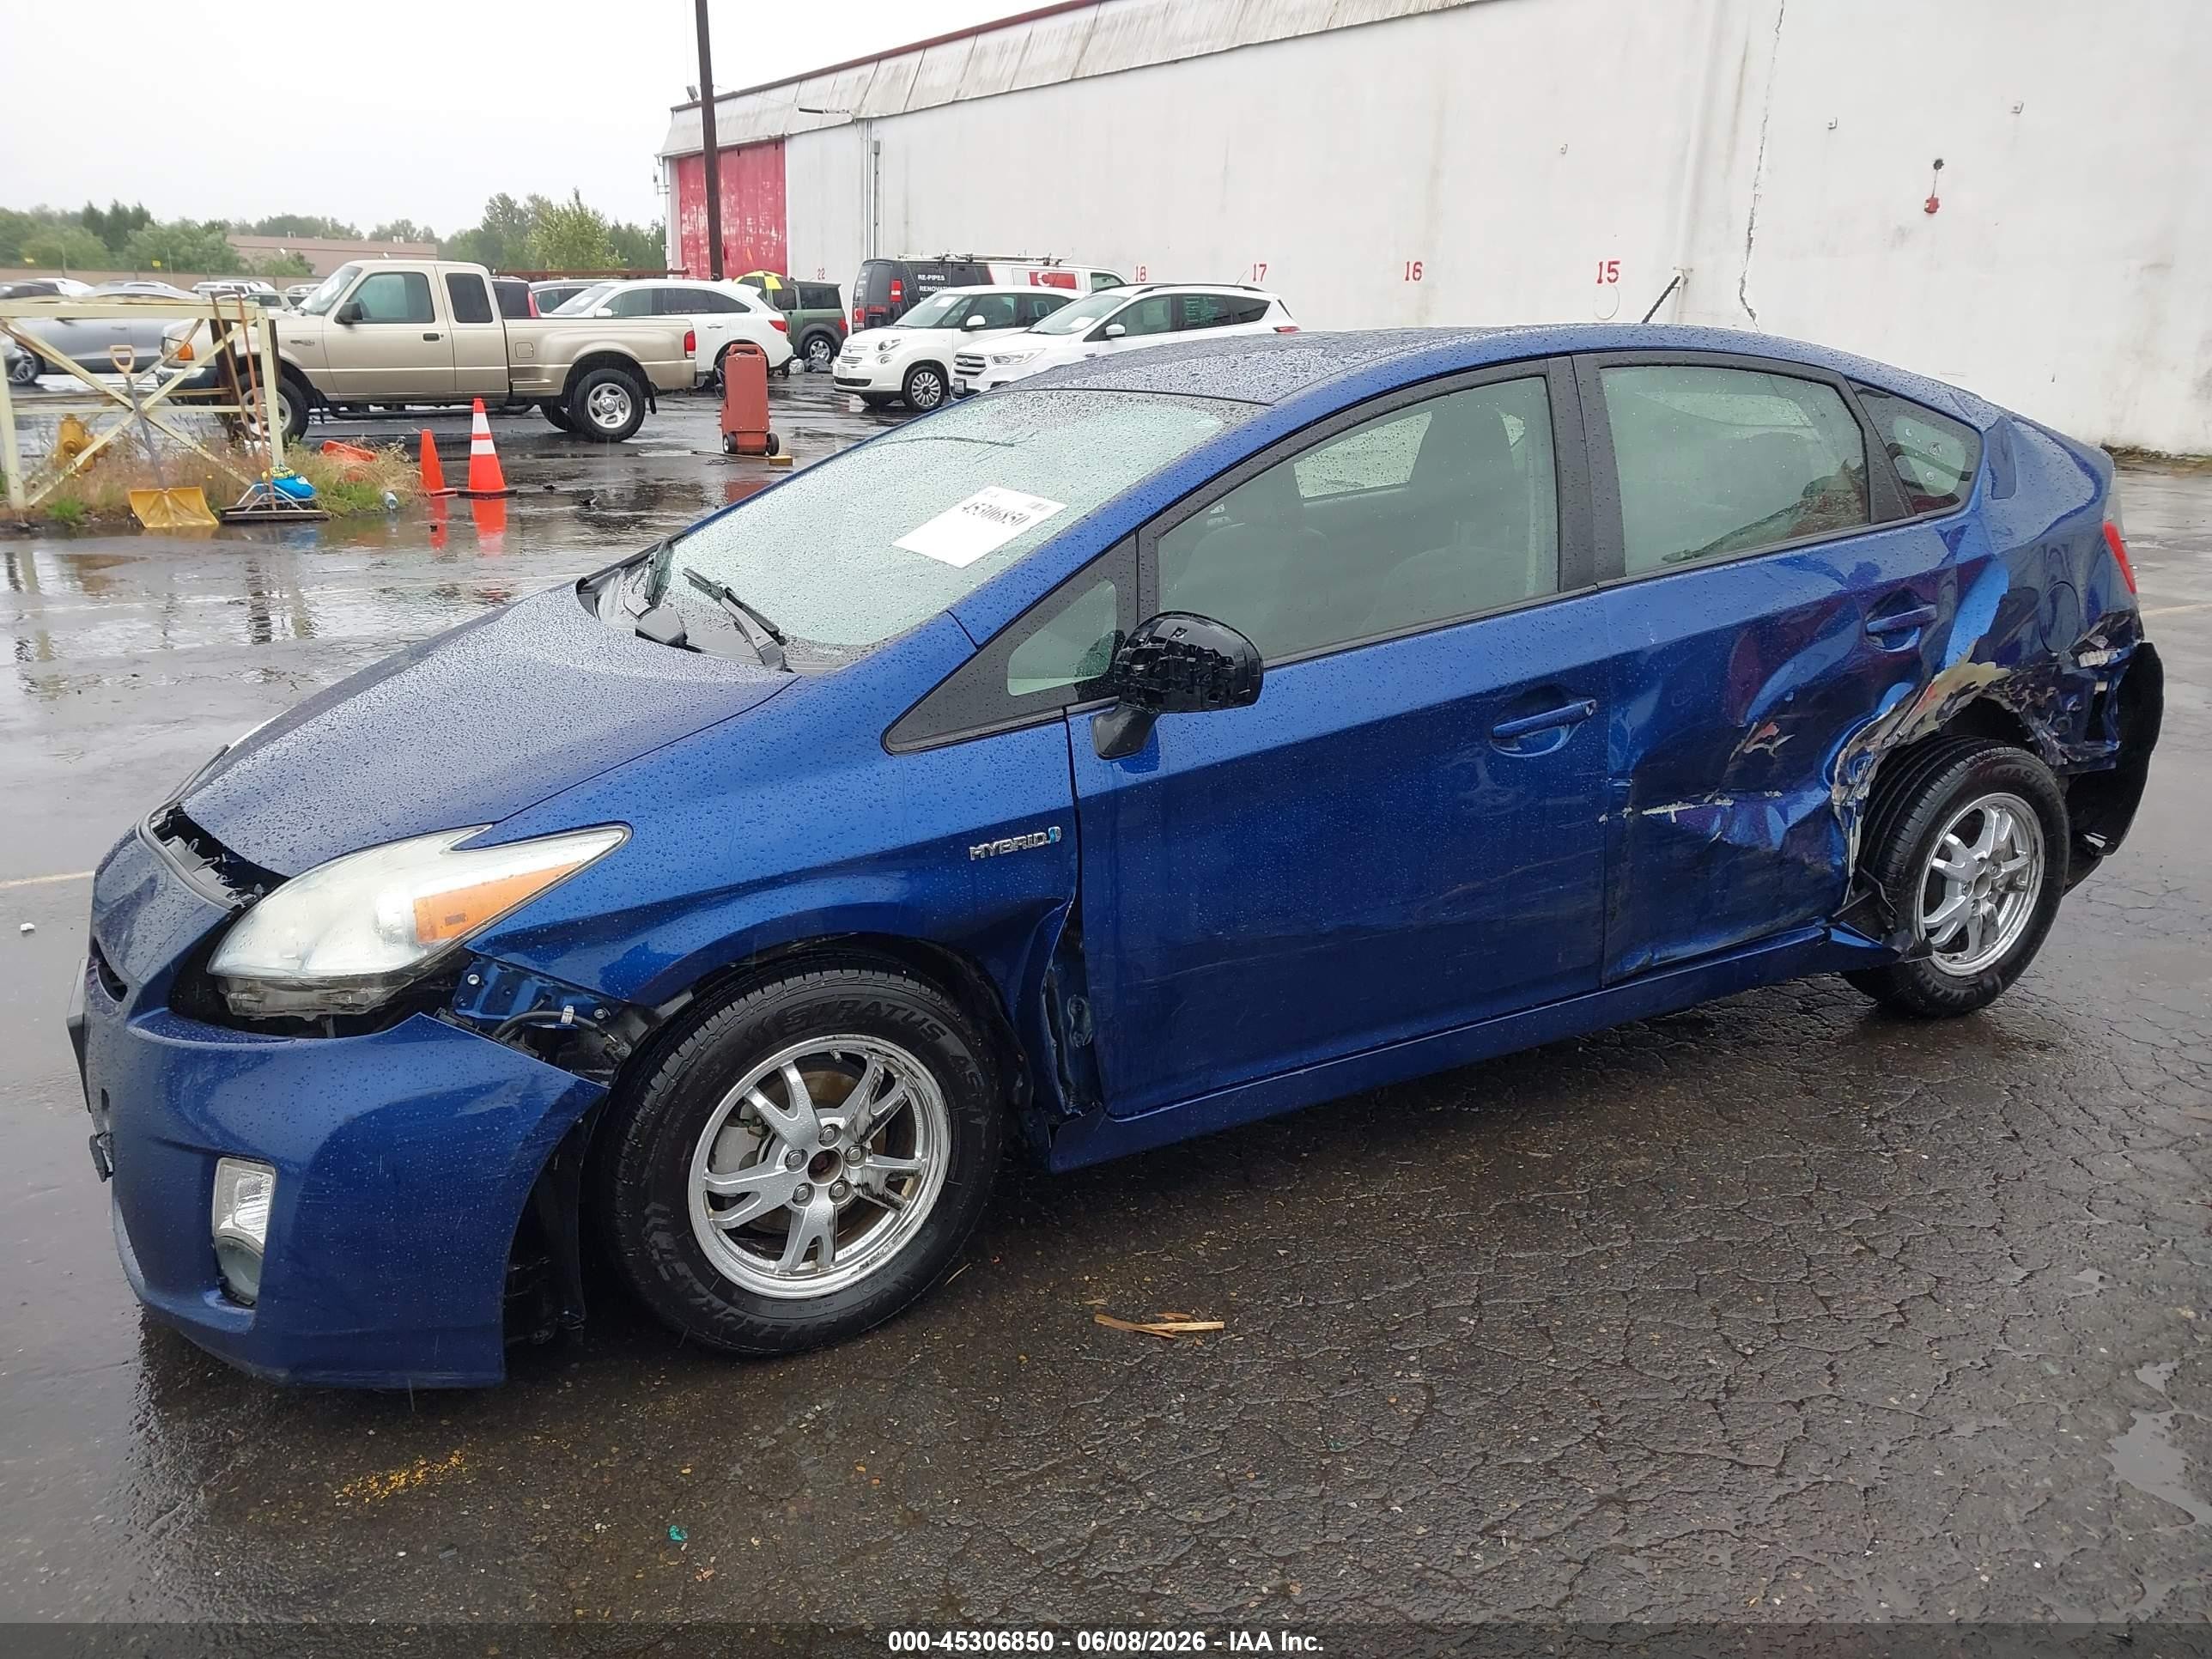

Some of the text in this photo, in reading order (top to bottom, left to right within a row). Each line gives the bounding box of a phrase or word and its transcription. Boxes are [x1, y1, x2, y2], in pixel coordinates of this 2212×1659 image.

[817, 267, 825, 281] 22
[1135, 265, 1146, 282] 18
[1252, 264, 1267, 282] 17
[1405, 261, 1423, 281] 16
[1596, 260, 1620, 284] 15
[969, 831, 1048, 860] HYBRID
